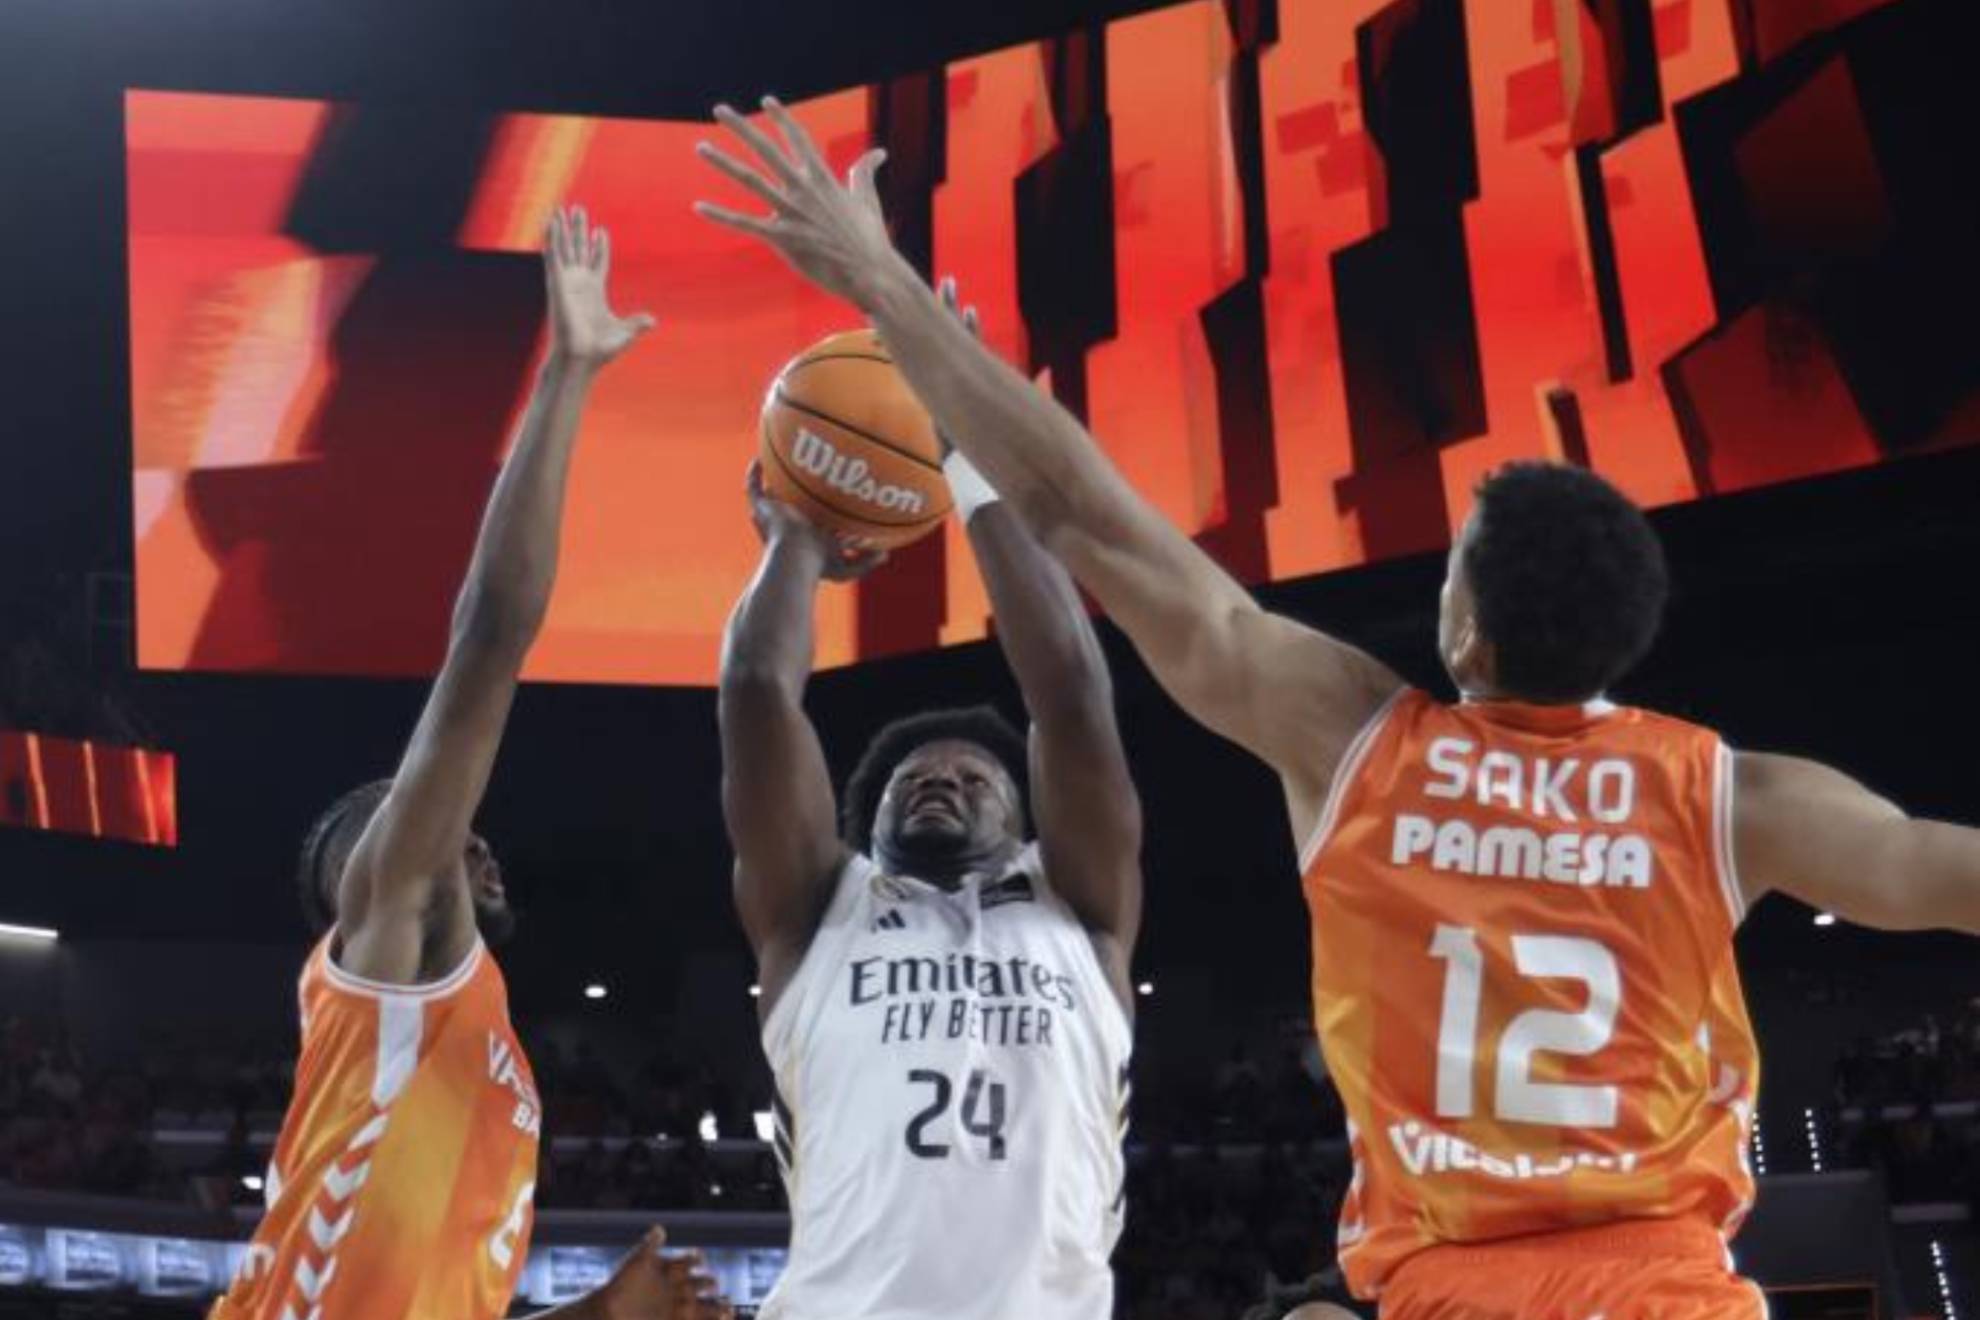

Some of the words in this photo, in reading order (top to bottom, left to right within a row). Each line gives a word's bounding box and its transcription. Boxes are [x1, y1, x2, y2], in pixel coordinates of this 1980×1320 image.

[791, 428, 924, 513] Wilson
[1424, 736, 1635, 822] SAKO
[1392, 814, 1652, 888] PAMESA
[881, 1001, 934, 1044] FLY
[1428, 923, 1620, 1127] 12
[905, 1069, 1006, 1161] 24
